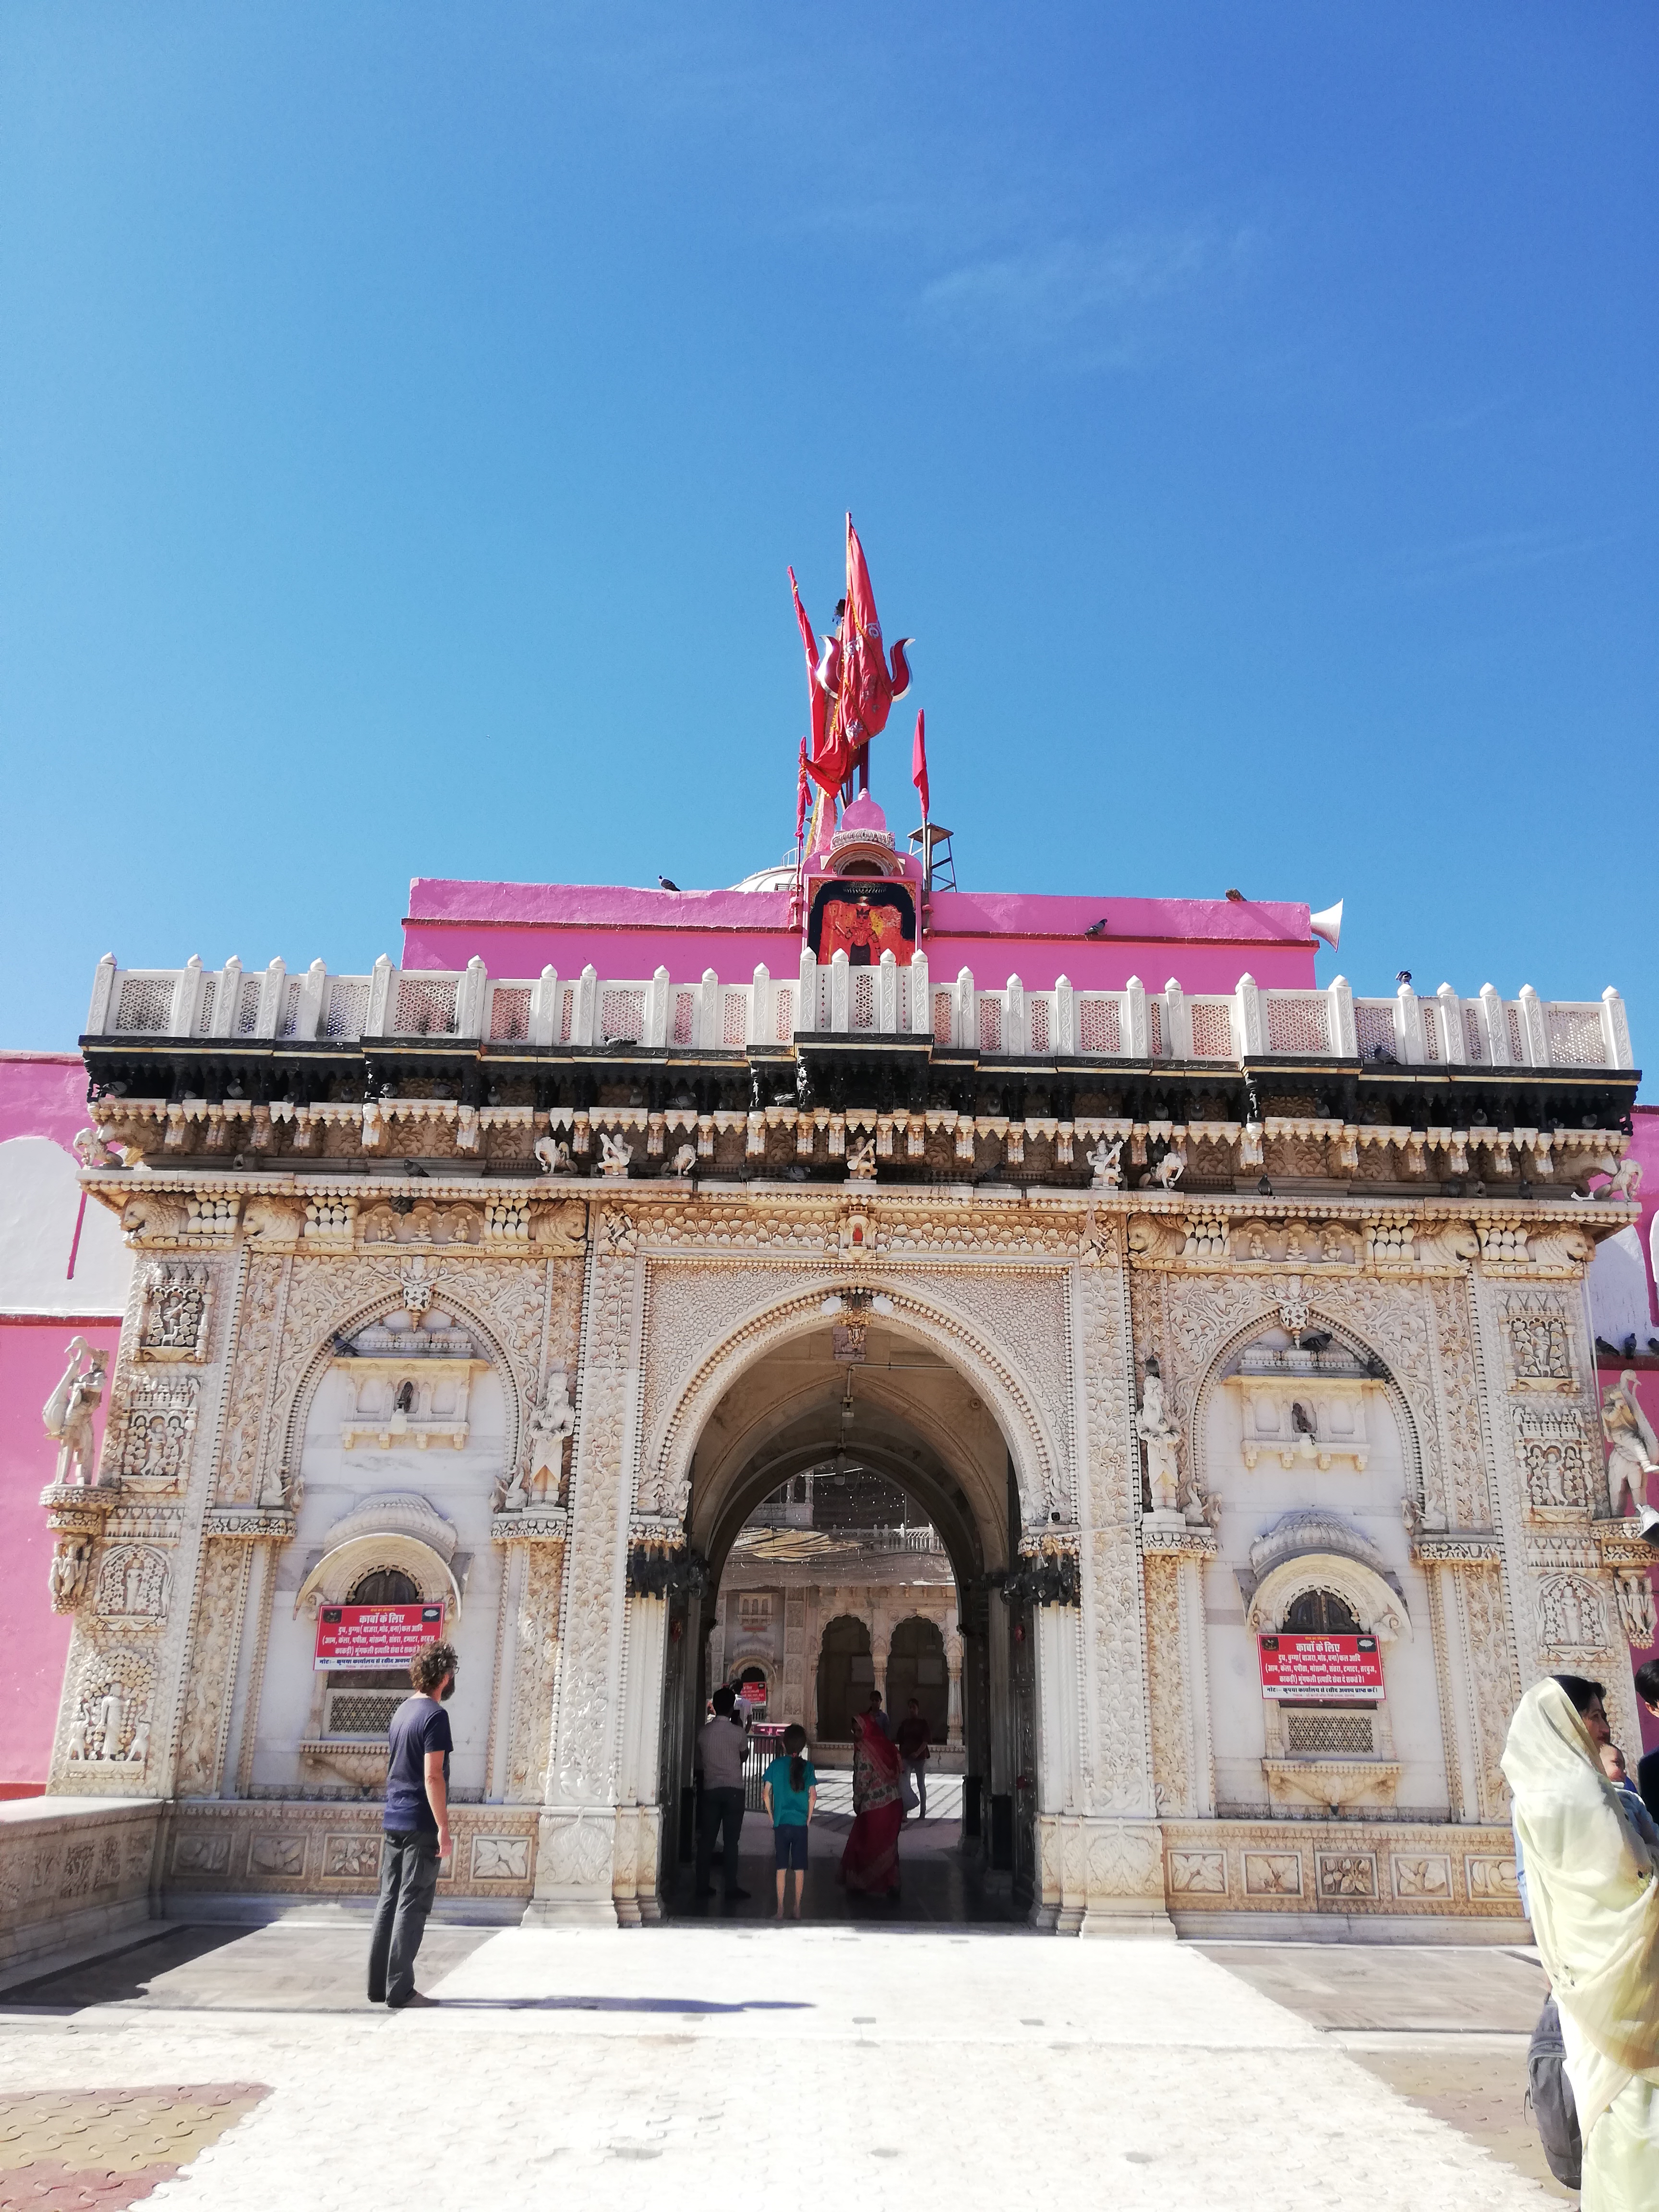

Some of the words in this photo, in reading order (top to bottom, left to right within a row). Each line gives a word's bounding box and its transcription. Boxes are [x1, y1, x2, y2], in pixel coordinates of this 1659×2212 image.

[380, 1612, 388, 1623] के
[388, 1612, 405, 1623] लिए
[1315, 1641, 1323, 1652] के
[1324, 1642, 1340, 1652] लिए
